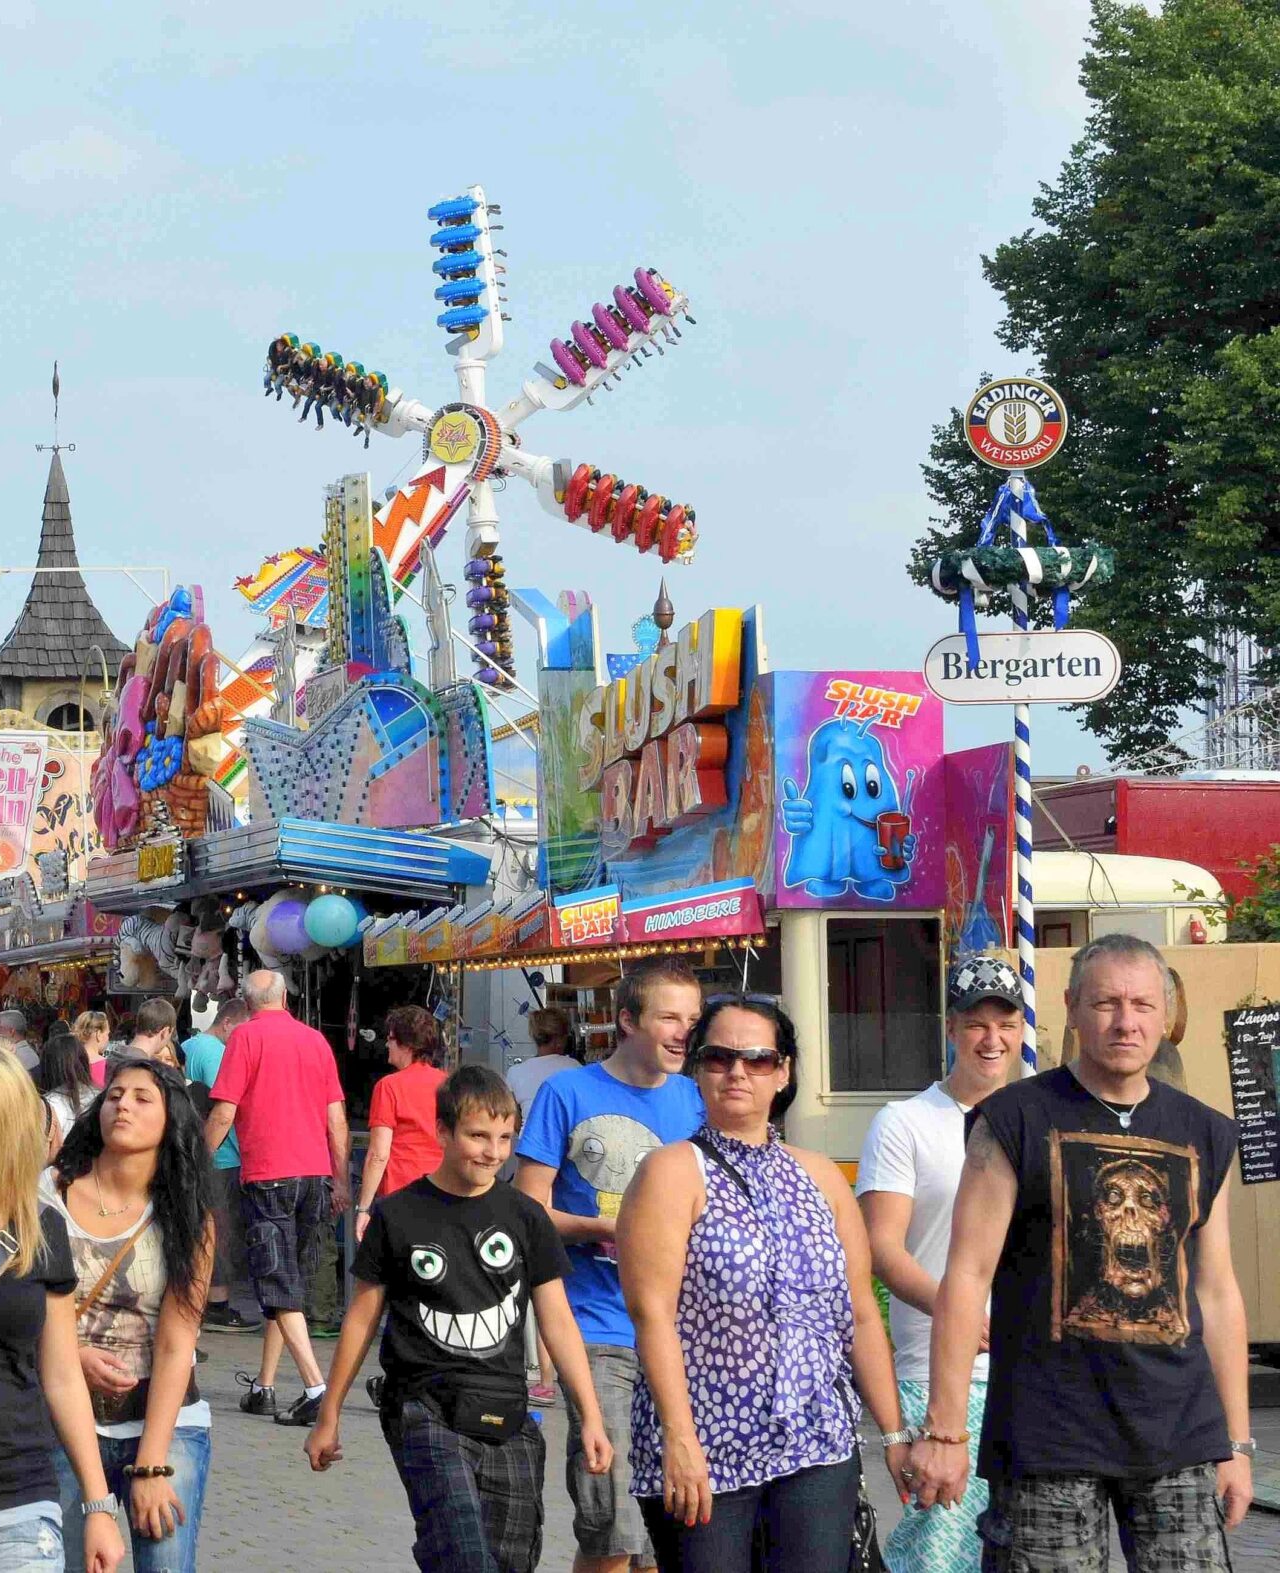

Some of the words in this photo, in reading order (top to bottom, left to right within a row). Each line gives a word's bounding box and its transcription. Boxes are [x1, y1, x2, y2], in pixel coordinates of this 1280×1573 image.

[972, 384, 1057, 419] ERDINGER
[941, 651, 1101, 686] Biergarten
[578, 609, 730, 794] SLUSH
[825, 680, 923, 716] SLUSH
[834, 699, 902, 728] BAR
[600, 722, 708, 852] BAR
[559, 897, 619, 931] SLUSH
[570, 917, 614, 943] BAR
[643, 896, 742, 934] HIMBEERE
[1233, 1010, 1279, 1027] Lángos
